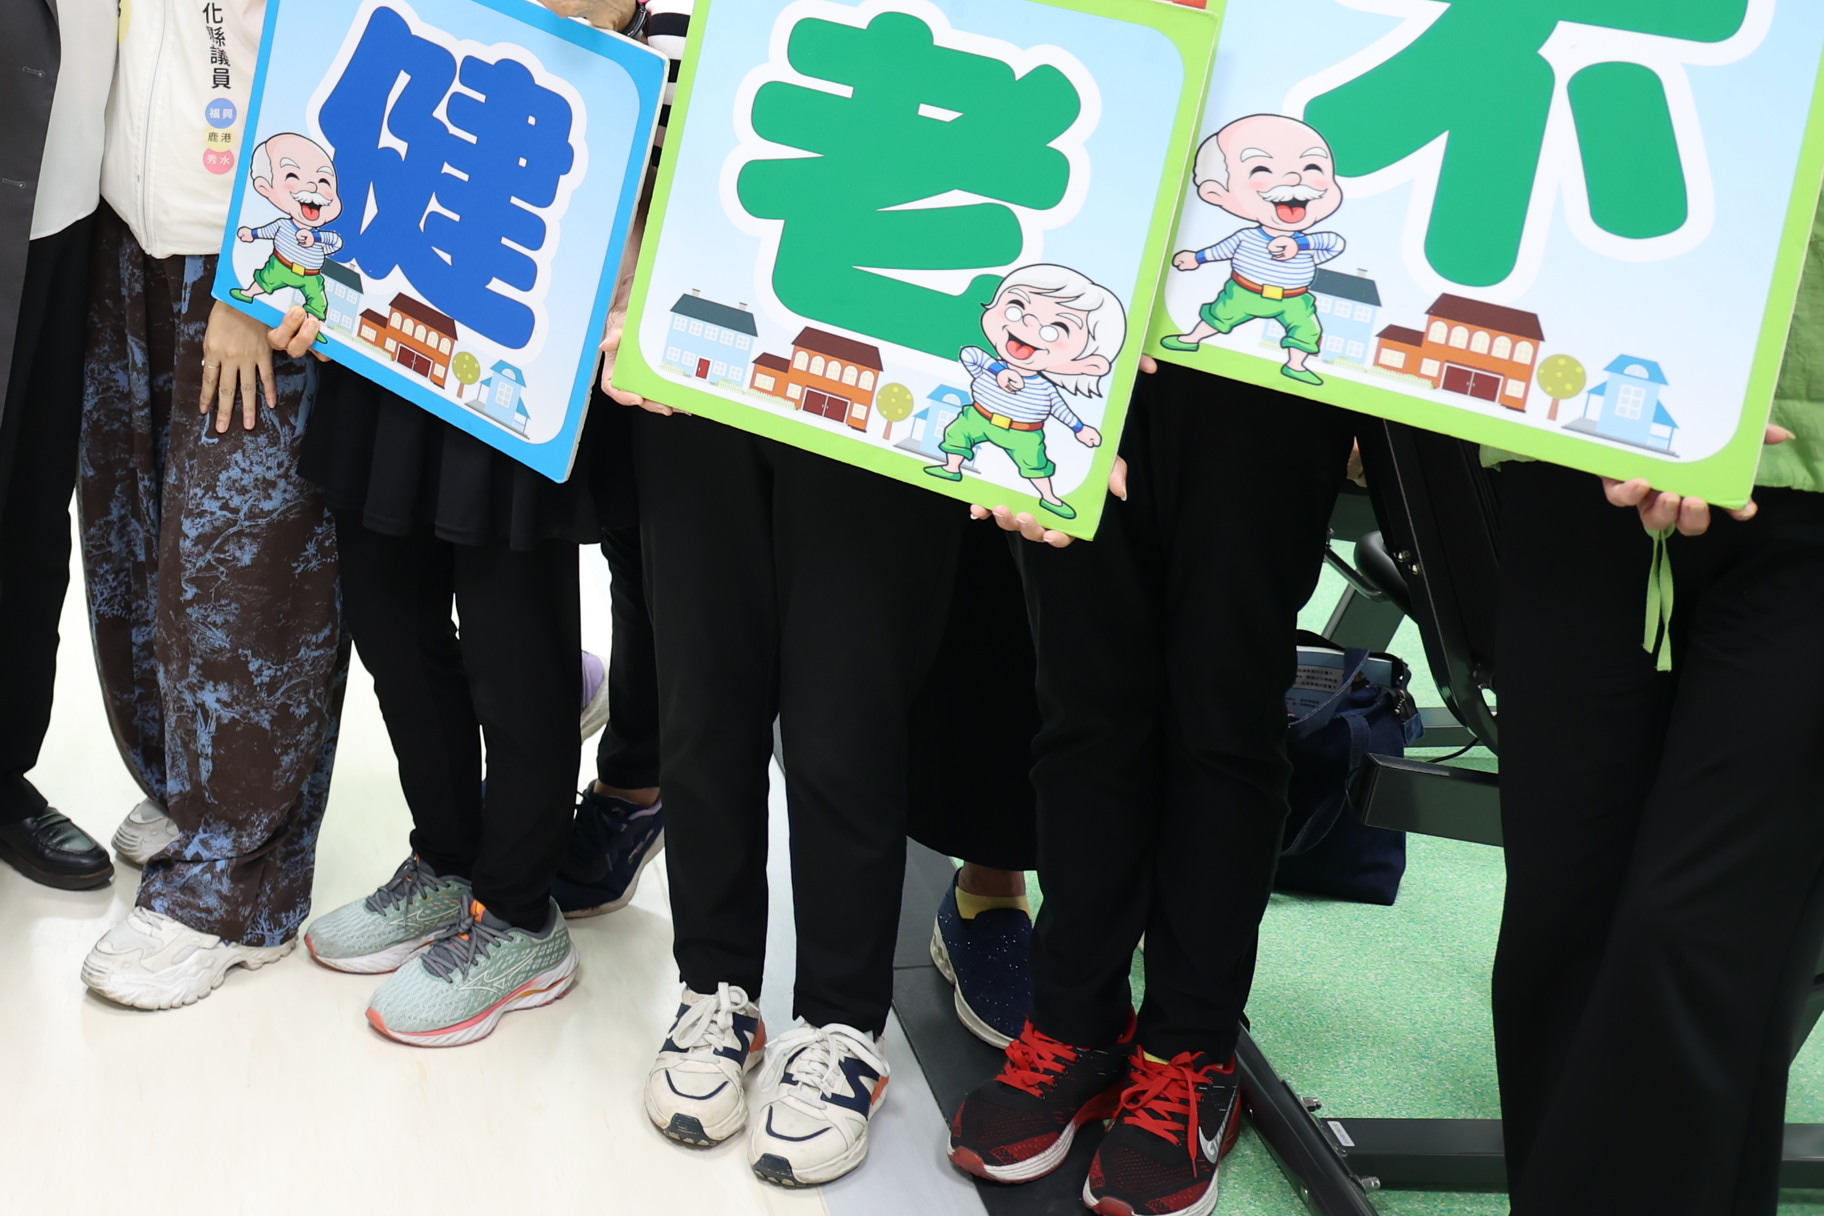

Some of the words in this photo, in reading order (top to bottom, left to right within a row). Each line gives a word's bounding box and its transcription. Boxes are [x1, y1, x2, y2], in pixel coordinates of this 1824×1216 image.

[209, 107, 233, 119] 福興
[208, 132, 232, 143] 鹿港
[207, 154, 230, 165] 秀水
[318, 6, 573, 350] 健
[737, 11, 1081, 361] 老
